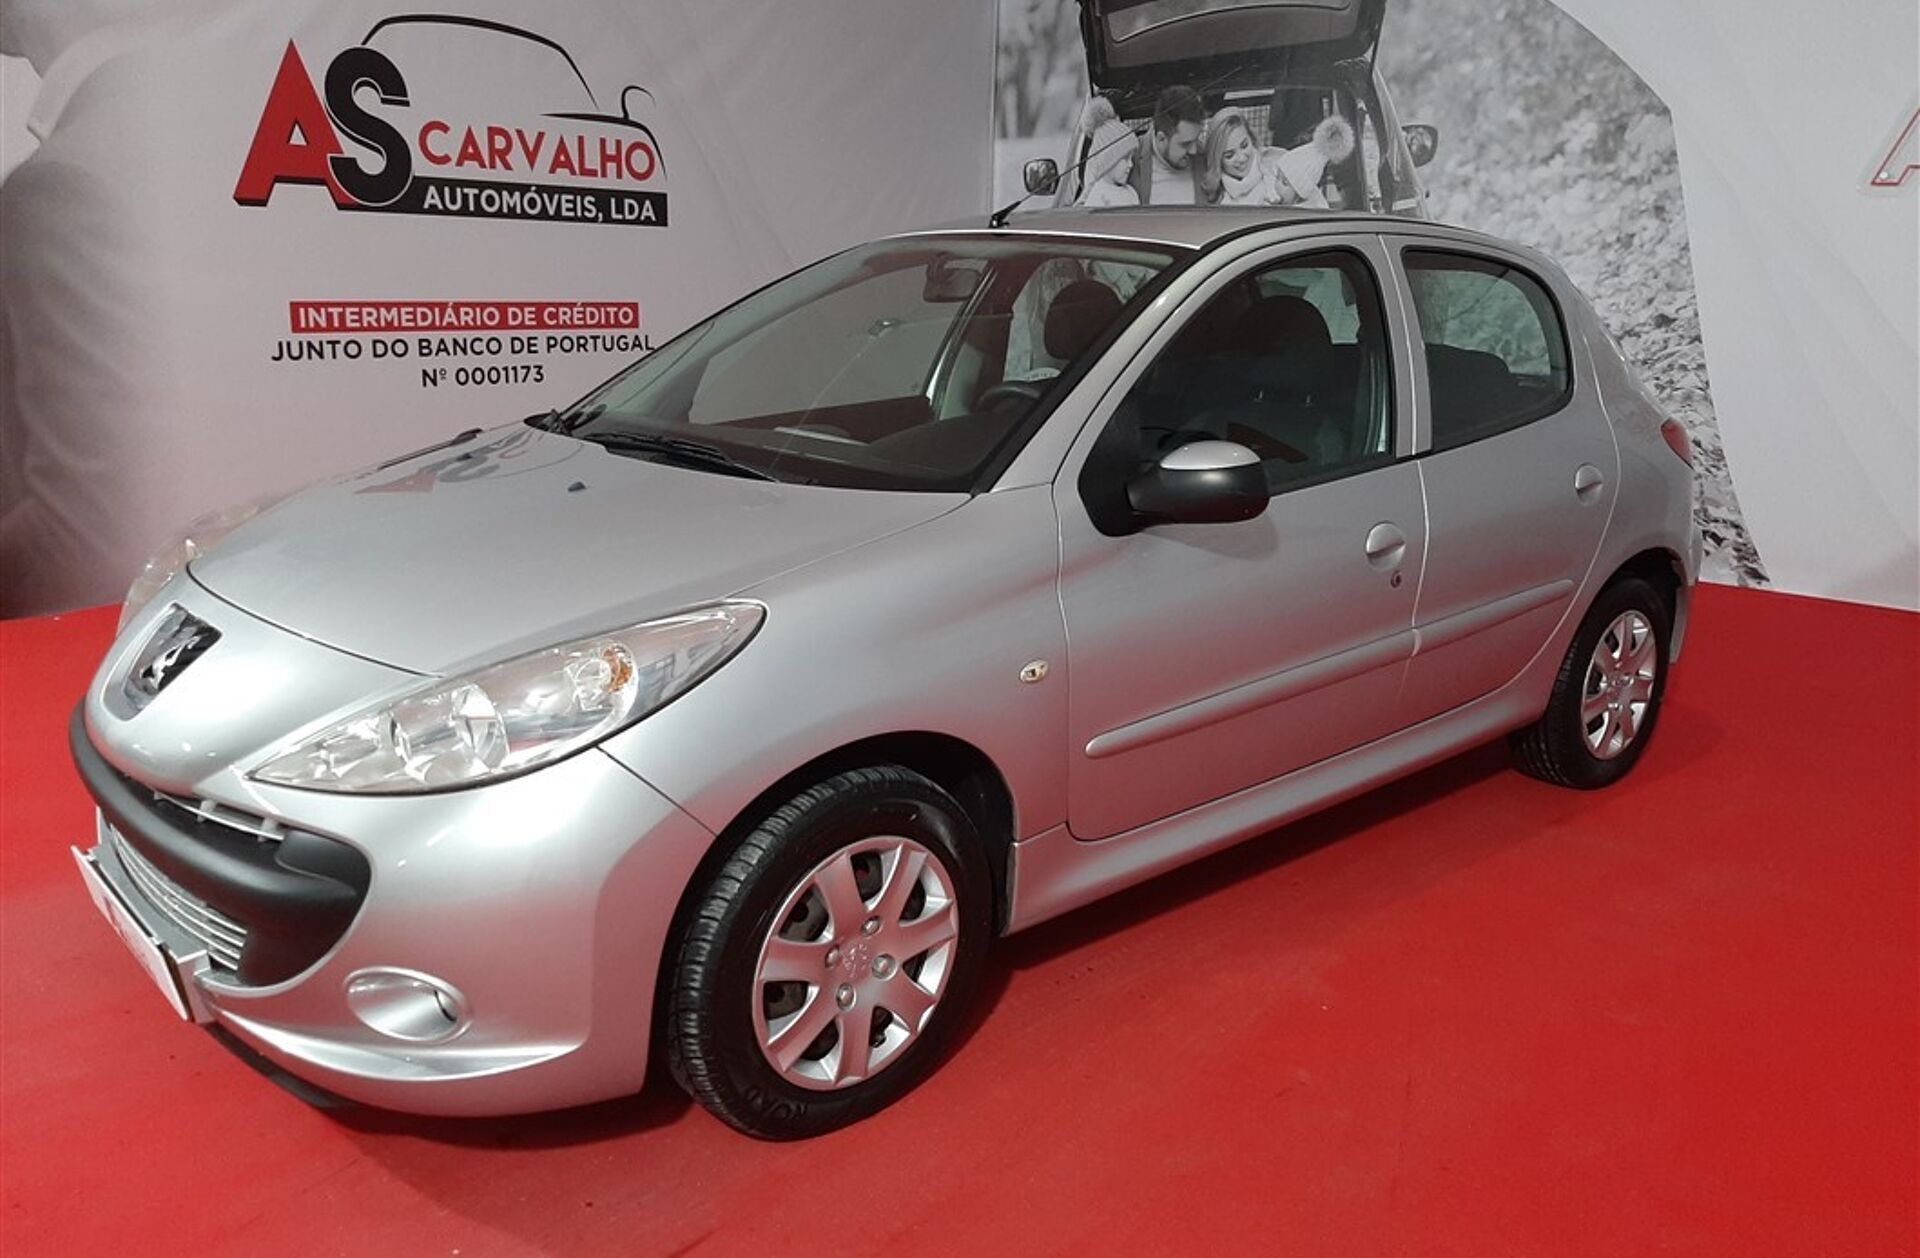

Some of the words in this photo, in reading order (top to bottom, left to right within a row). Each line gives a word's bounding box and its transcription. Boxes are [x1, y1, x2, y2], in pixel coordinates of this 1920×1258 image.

[233, 38, 413, 206] AS
[418, 120, 656, 182] CARVALHO
[423, 185, 604, 222] AUTOMÓVEIS,
[610, 200, 657, 221] LDA
[299, 302, 500, 328] INTERMEDIÁRIO
[507, 308, 536, 326] DE
[543, 302, 634, 326] CRÉDITO
[271, 339, 363, 361] JUNTO
[372, 340, 410, 359] DO
[418, 337, 502, 358] BANCO
[510, 337, 538, 355] DE
[546, 334, 655, 354] PORTUGAL
[455, 365, 545, 386] 0001173
